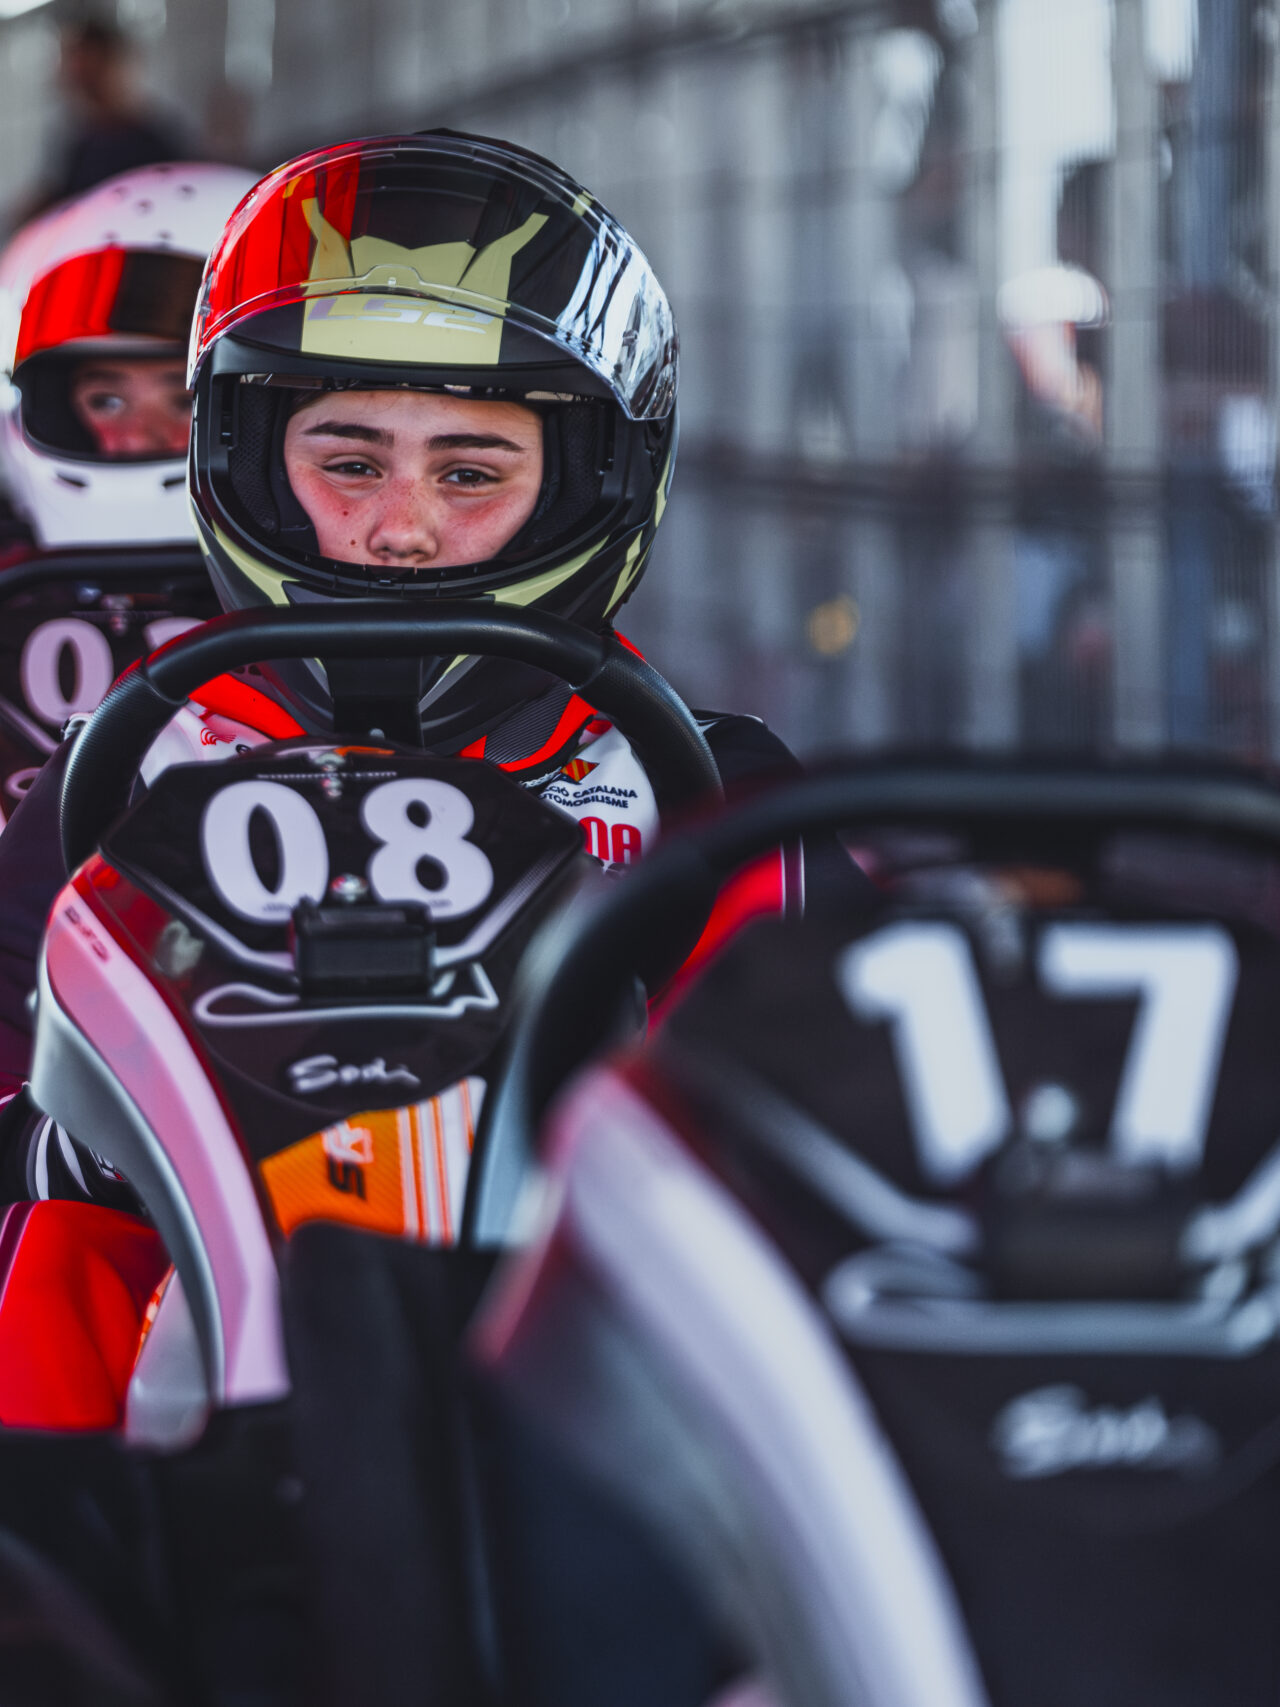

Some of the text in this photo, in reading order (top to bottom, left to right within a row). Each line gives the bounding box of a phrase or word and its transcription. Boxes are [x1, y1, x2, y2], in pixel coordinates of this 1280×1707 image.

[307, 297, 497, 335] LS2
[573, 785, 638, 798] CATALANA
[201, 778, 494, 922] 08
[838, 923, 1238, 1180] 17
